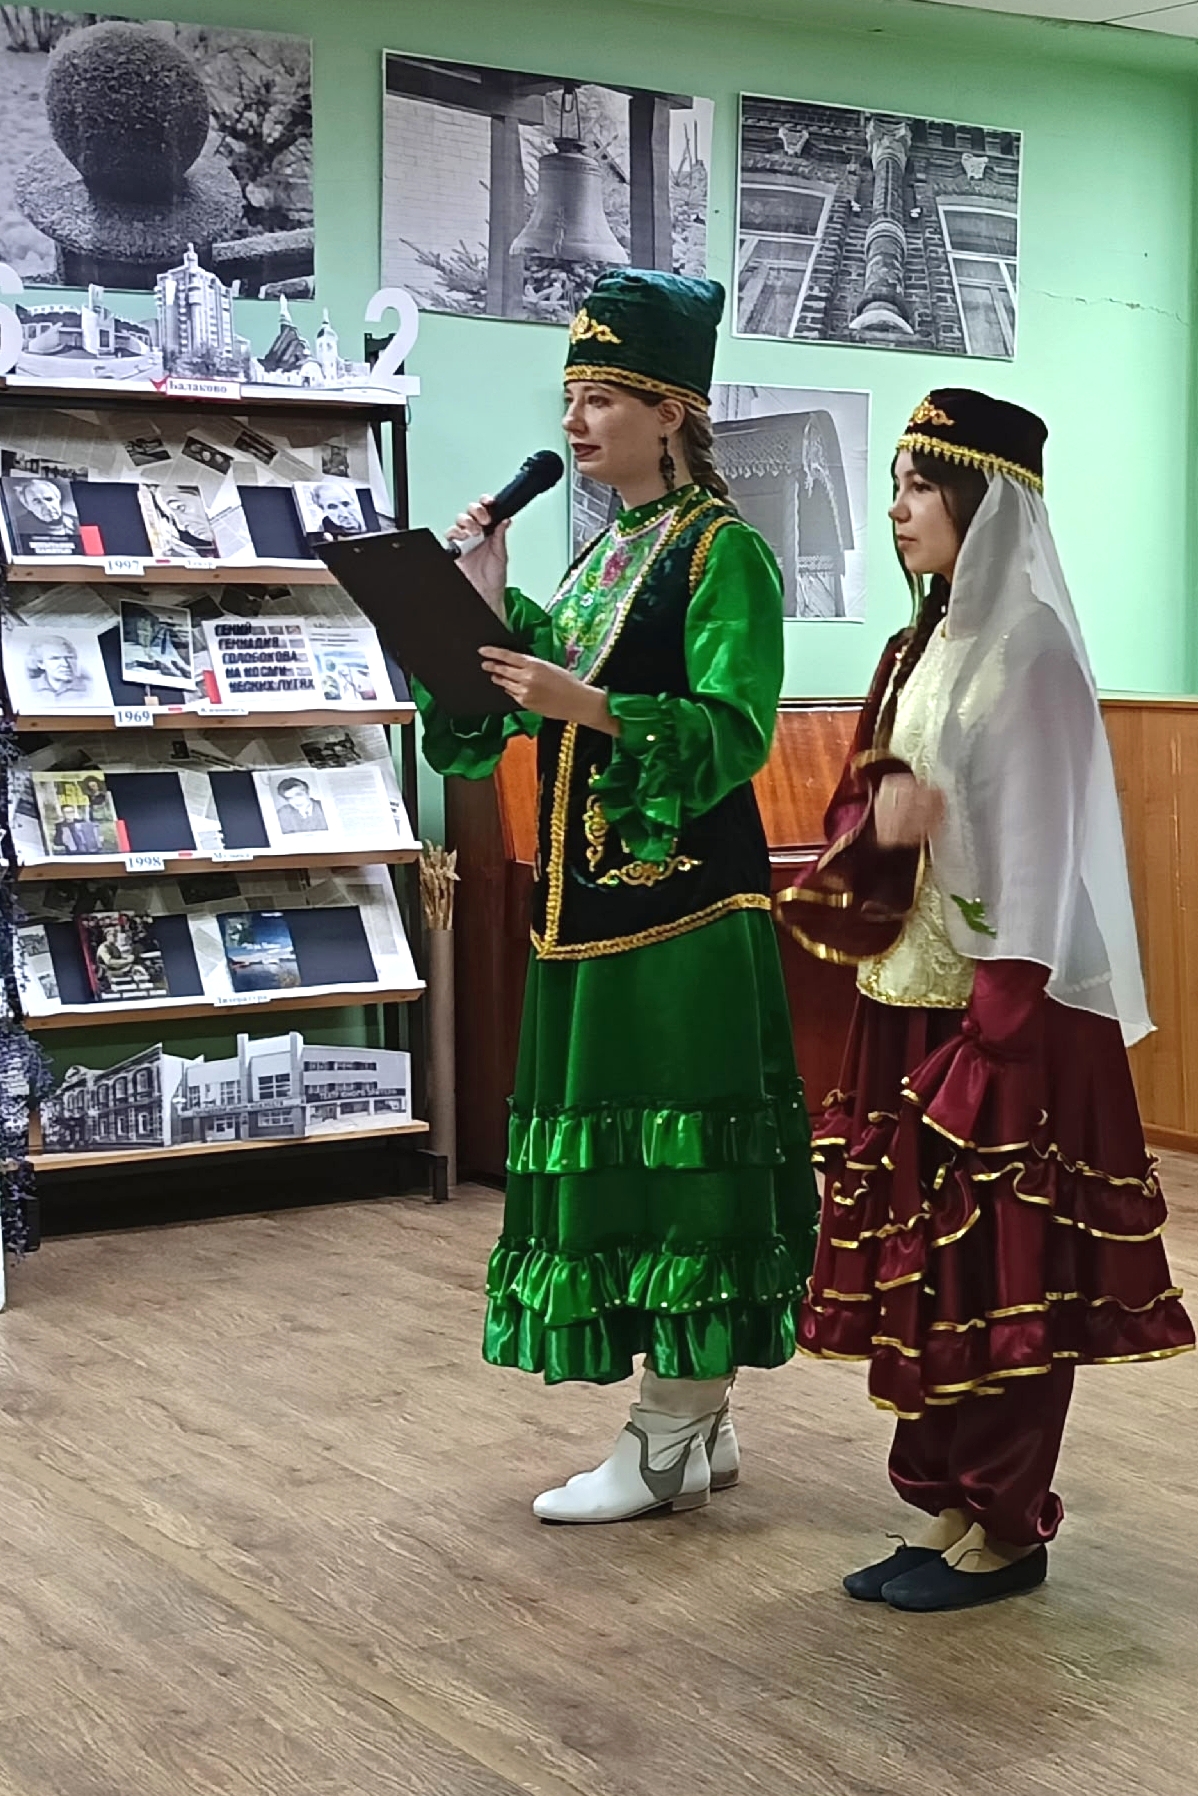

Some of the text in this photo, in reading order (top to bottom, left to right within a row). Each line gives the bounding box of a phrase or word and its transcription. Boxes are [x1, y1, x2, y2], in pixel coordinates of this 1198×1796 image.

[365, 288, 421, 396] 2
[169, 380, 228, 394] Балаково
[107, 560, 139, 571] 1997
[214, 621, 252, 637] ГЕНИЙ
[218, 637, 279, 650] ГЕННАДИЯ
[225, 667, 242, 679] НА
[117, 710, 151, 722] 1969
[128, 856, 162, 868] 1998
